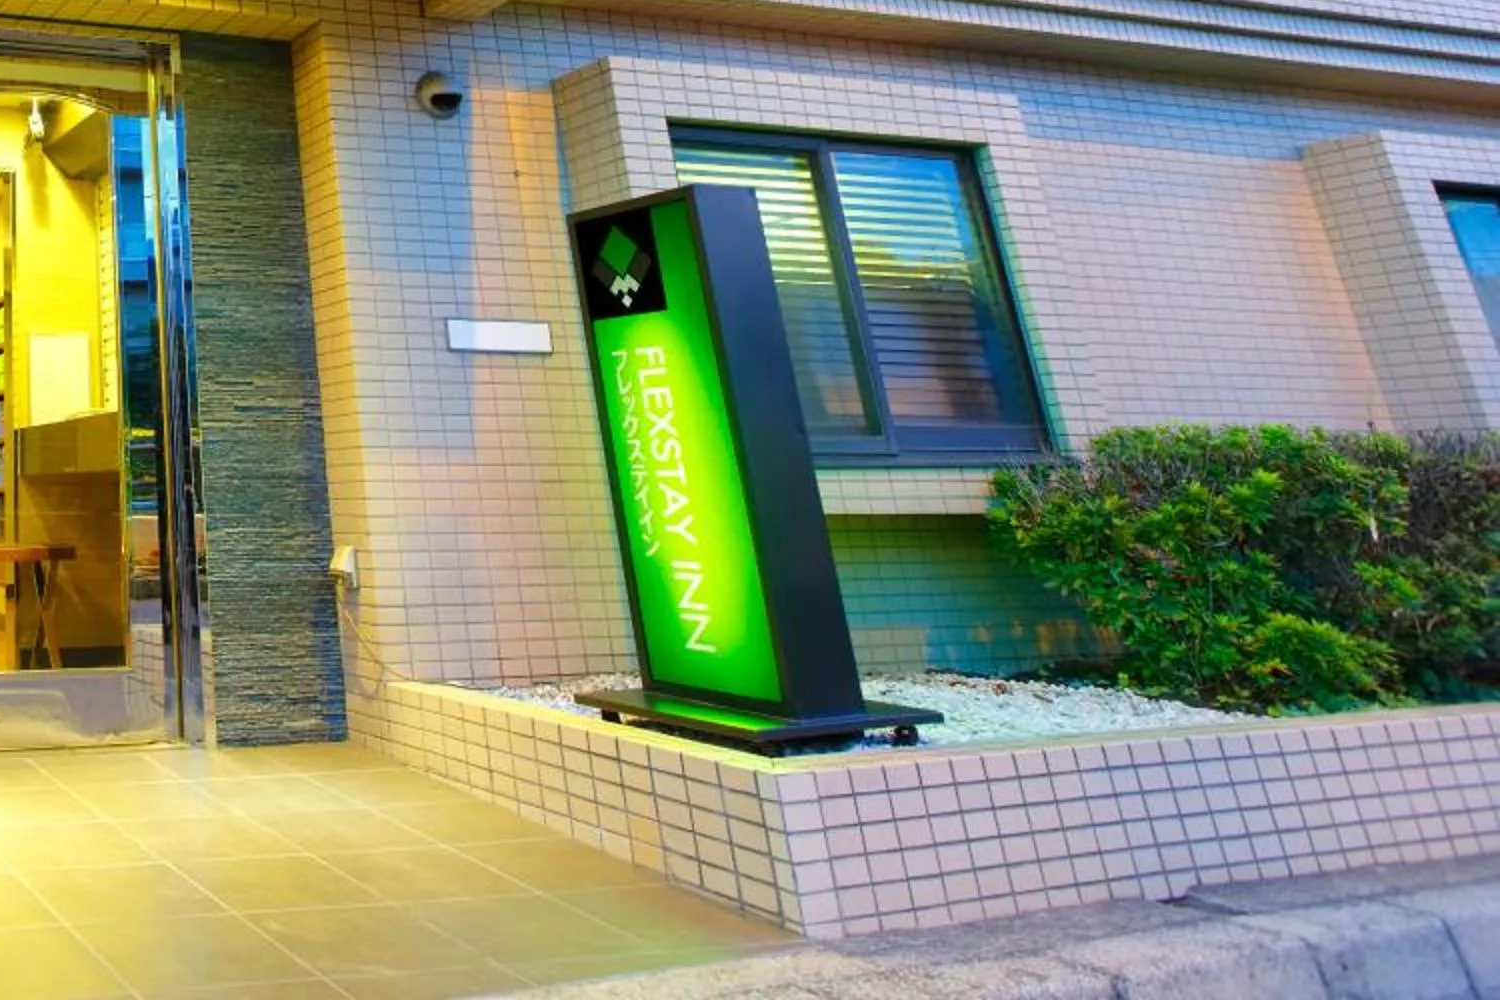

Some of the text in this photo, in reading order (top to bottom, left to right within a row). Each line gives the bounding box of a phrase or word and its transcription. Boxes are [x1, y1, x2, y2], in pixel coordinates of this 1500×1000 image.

[612, 351, 660, 557] フレックステイイン
[635, 346, 716, 653] FLEXSTAY INN
